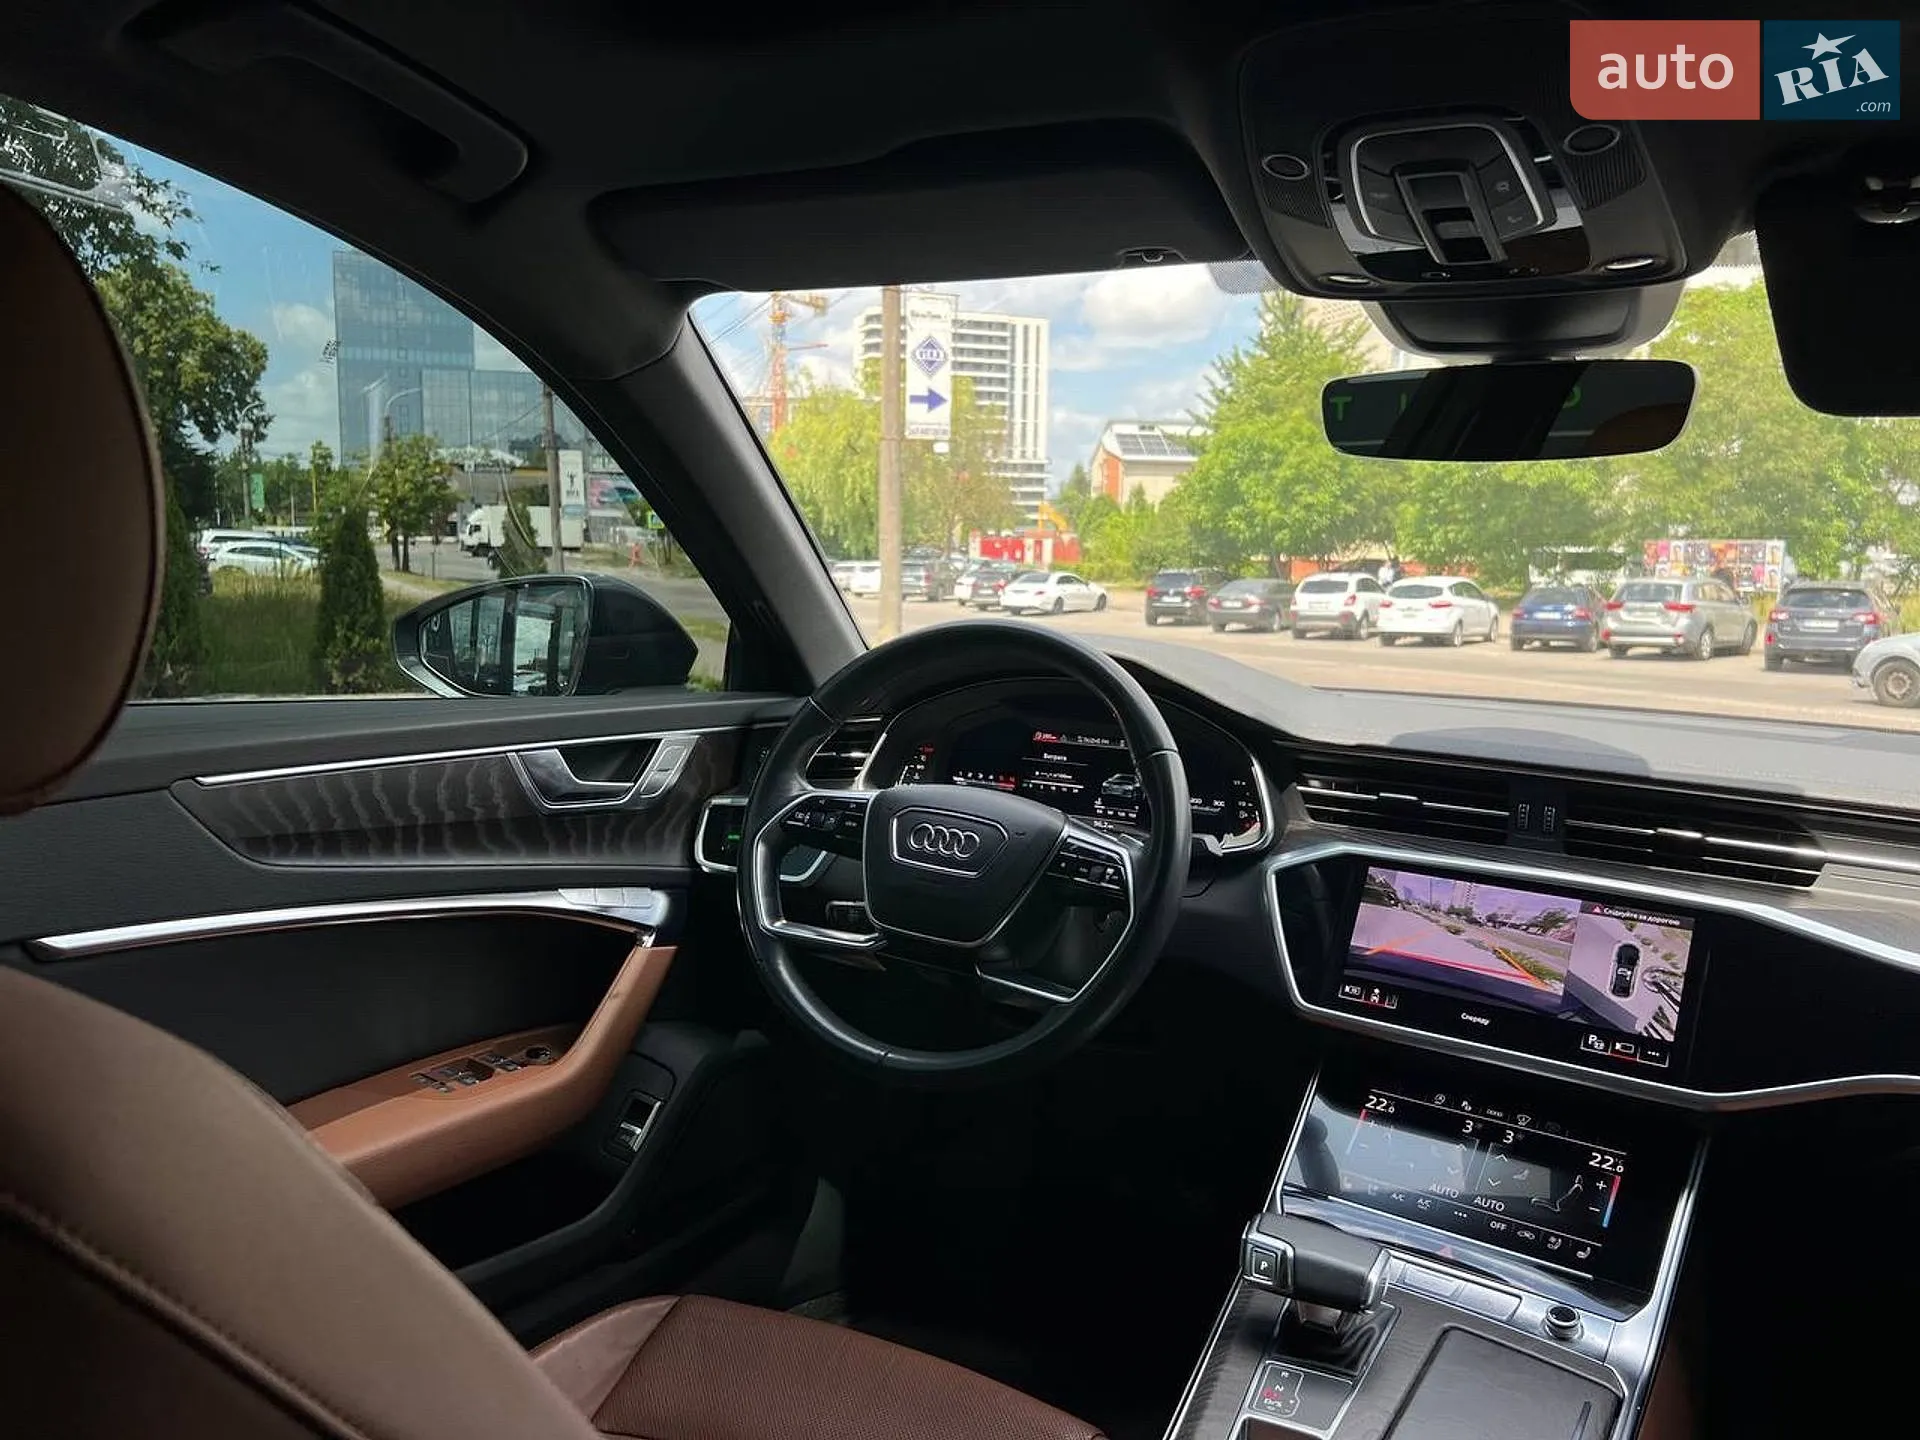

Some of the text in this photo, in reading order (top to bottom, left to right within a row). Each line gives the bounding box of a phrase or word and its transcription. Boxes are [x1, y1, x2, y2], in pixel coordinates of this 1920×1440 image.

[1462, 1120, 1474, 1133] 3
[1502, 1130, 1514, 1144] 3
[1429, 1183, 1459, 1199] AUTO
[1473, 1196, 1505, 1212] AUTO
[1489, 1221, 1507, 1231] OFF
[1260, 1261, 1268, 1270] P
